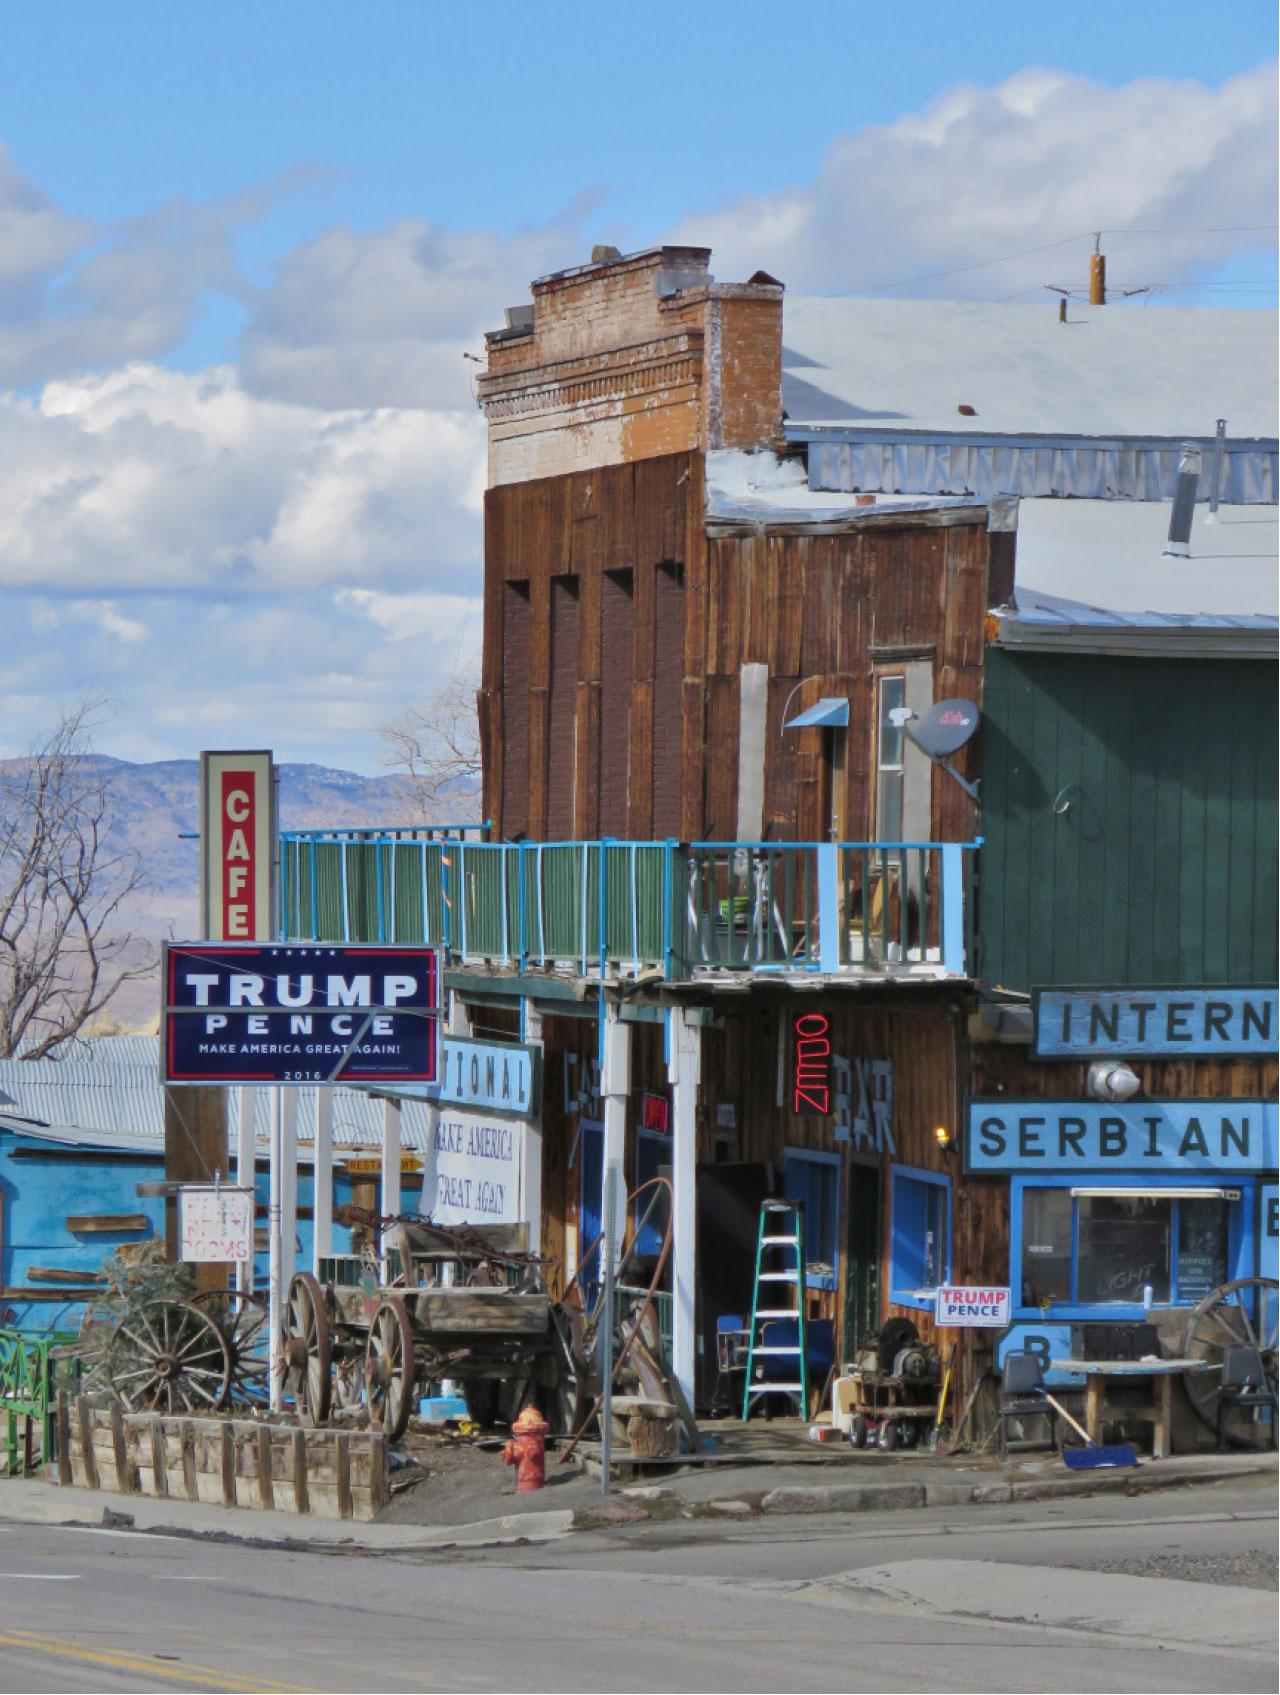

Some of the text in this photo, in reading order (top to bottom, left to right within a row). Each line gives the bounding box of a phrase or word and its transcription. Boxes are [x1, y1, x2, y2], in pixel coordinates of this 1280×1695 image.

[226, 789, 250, 937] CAFE
[185, 974, 418, 1008] TRUMP
[205, 1014, 394, 1036] PENCE
[1062, 1001, 1272, 1042] INTERN
[199, 1043, 401, 1055] MAKE AMERICA GREAT AGAIN!
[795, 1013, 831, 1113] OPEN
[284, 1070, 322, 1081] 2016
[832, 1053, 896, 1156] BAR
[467, 1126, 513, 1162] AMERICA
[979, 1117, 1250, 1157] SERBIAN
[437, 1173, 506, 1216] GREAT AGAIN
[943, 1290, 1006, 1304] TRUMP
[948, 1305, 999, 1316] PENCE
